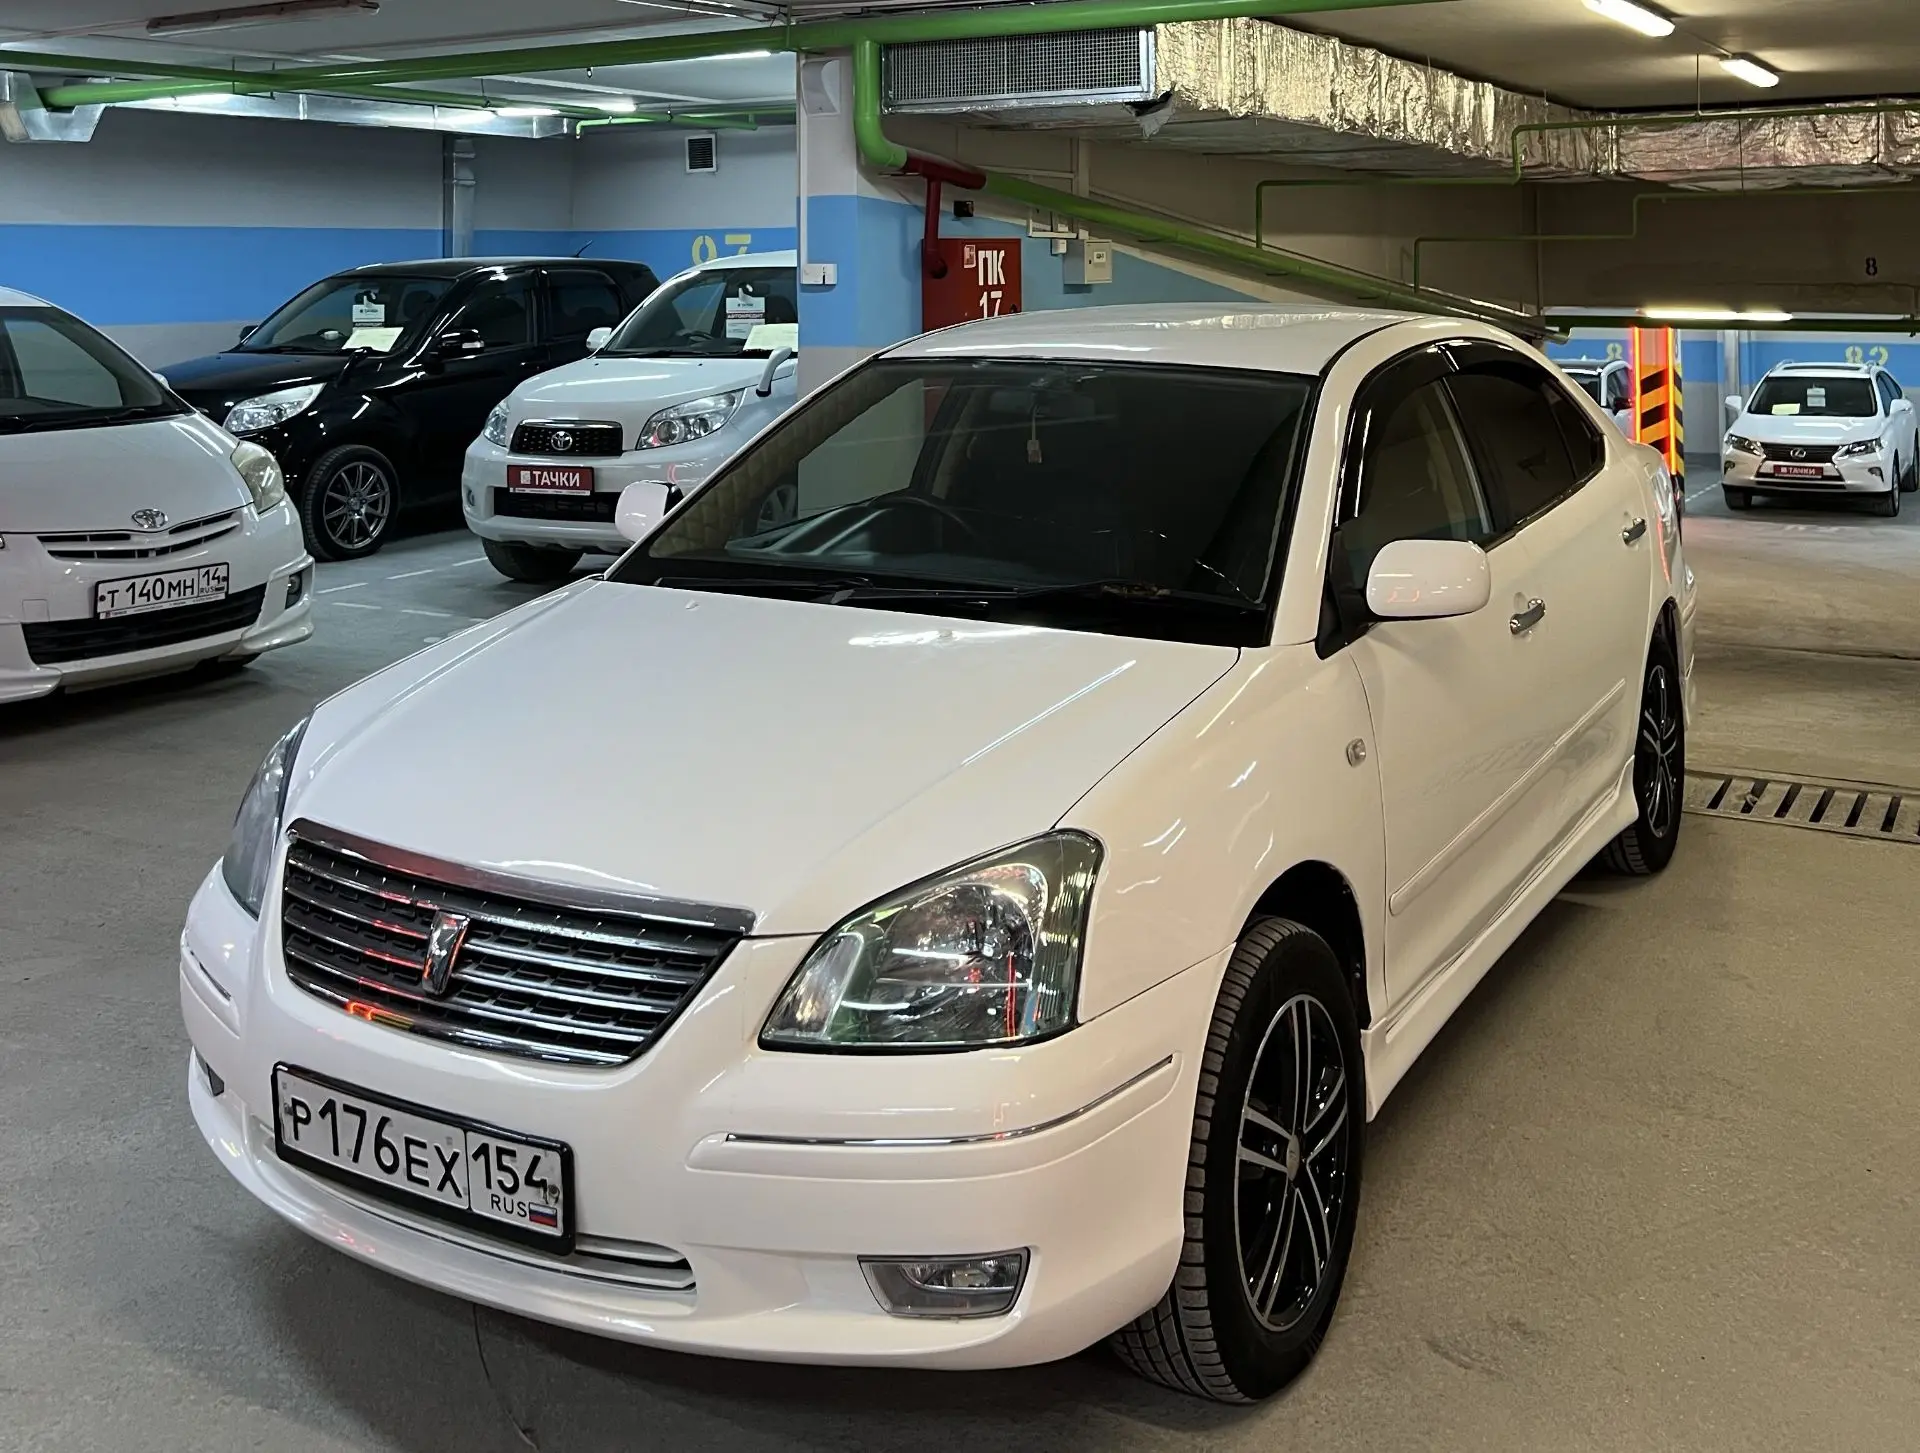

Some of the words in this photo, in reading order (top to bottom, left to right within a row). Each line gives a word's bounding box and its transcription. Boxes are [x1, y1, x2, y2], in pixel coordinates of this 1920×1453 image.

[978, 250, 1006, 286] ПК
[1865, 257, 1878, 276] 8
[979, 290, 1003, 319] 17
[532, 471, 580, 487] ТАЧКИ
[1789, 467, 1816, 475] ТАЧКИ
[202, 567, 221, 587] 14
[290, 1096, 463, 1199] Р176ЕХ
[471, 1141, 548, 1200] 154
[490, 1193, 528, 1218] RUS
